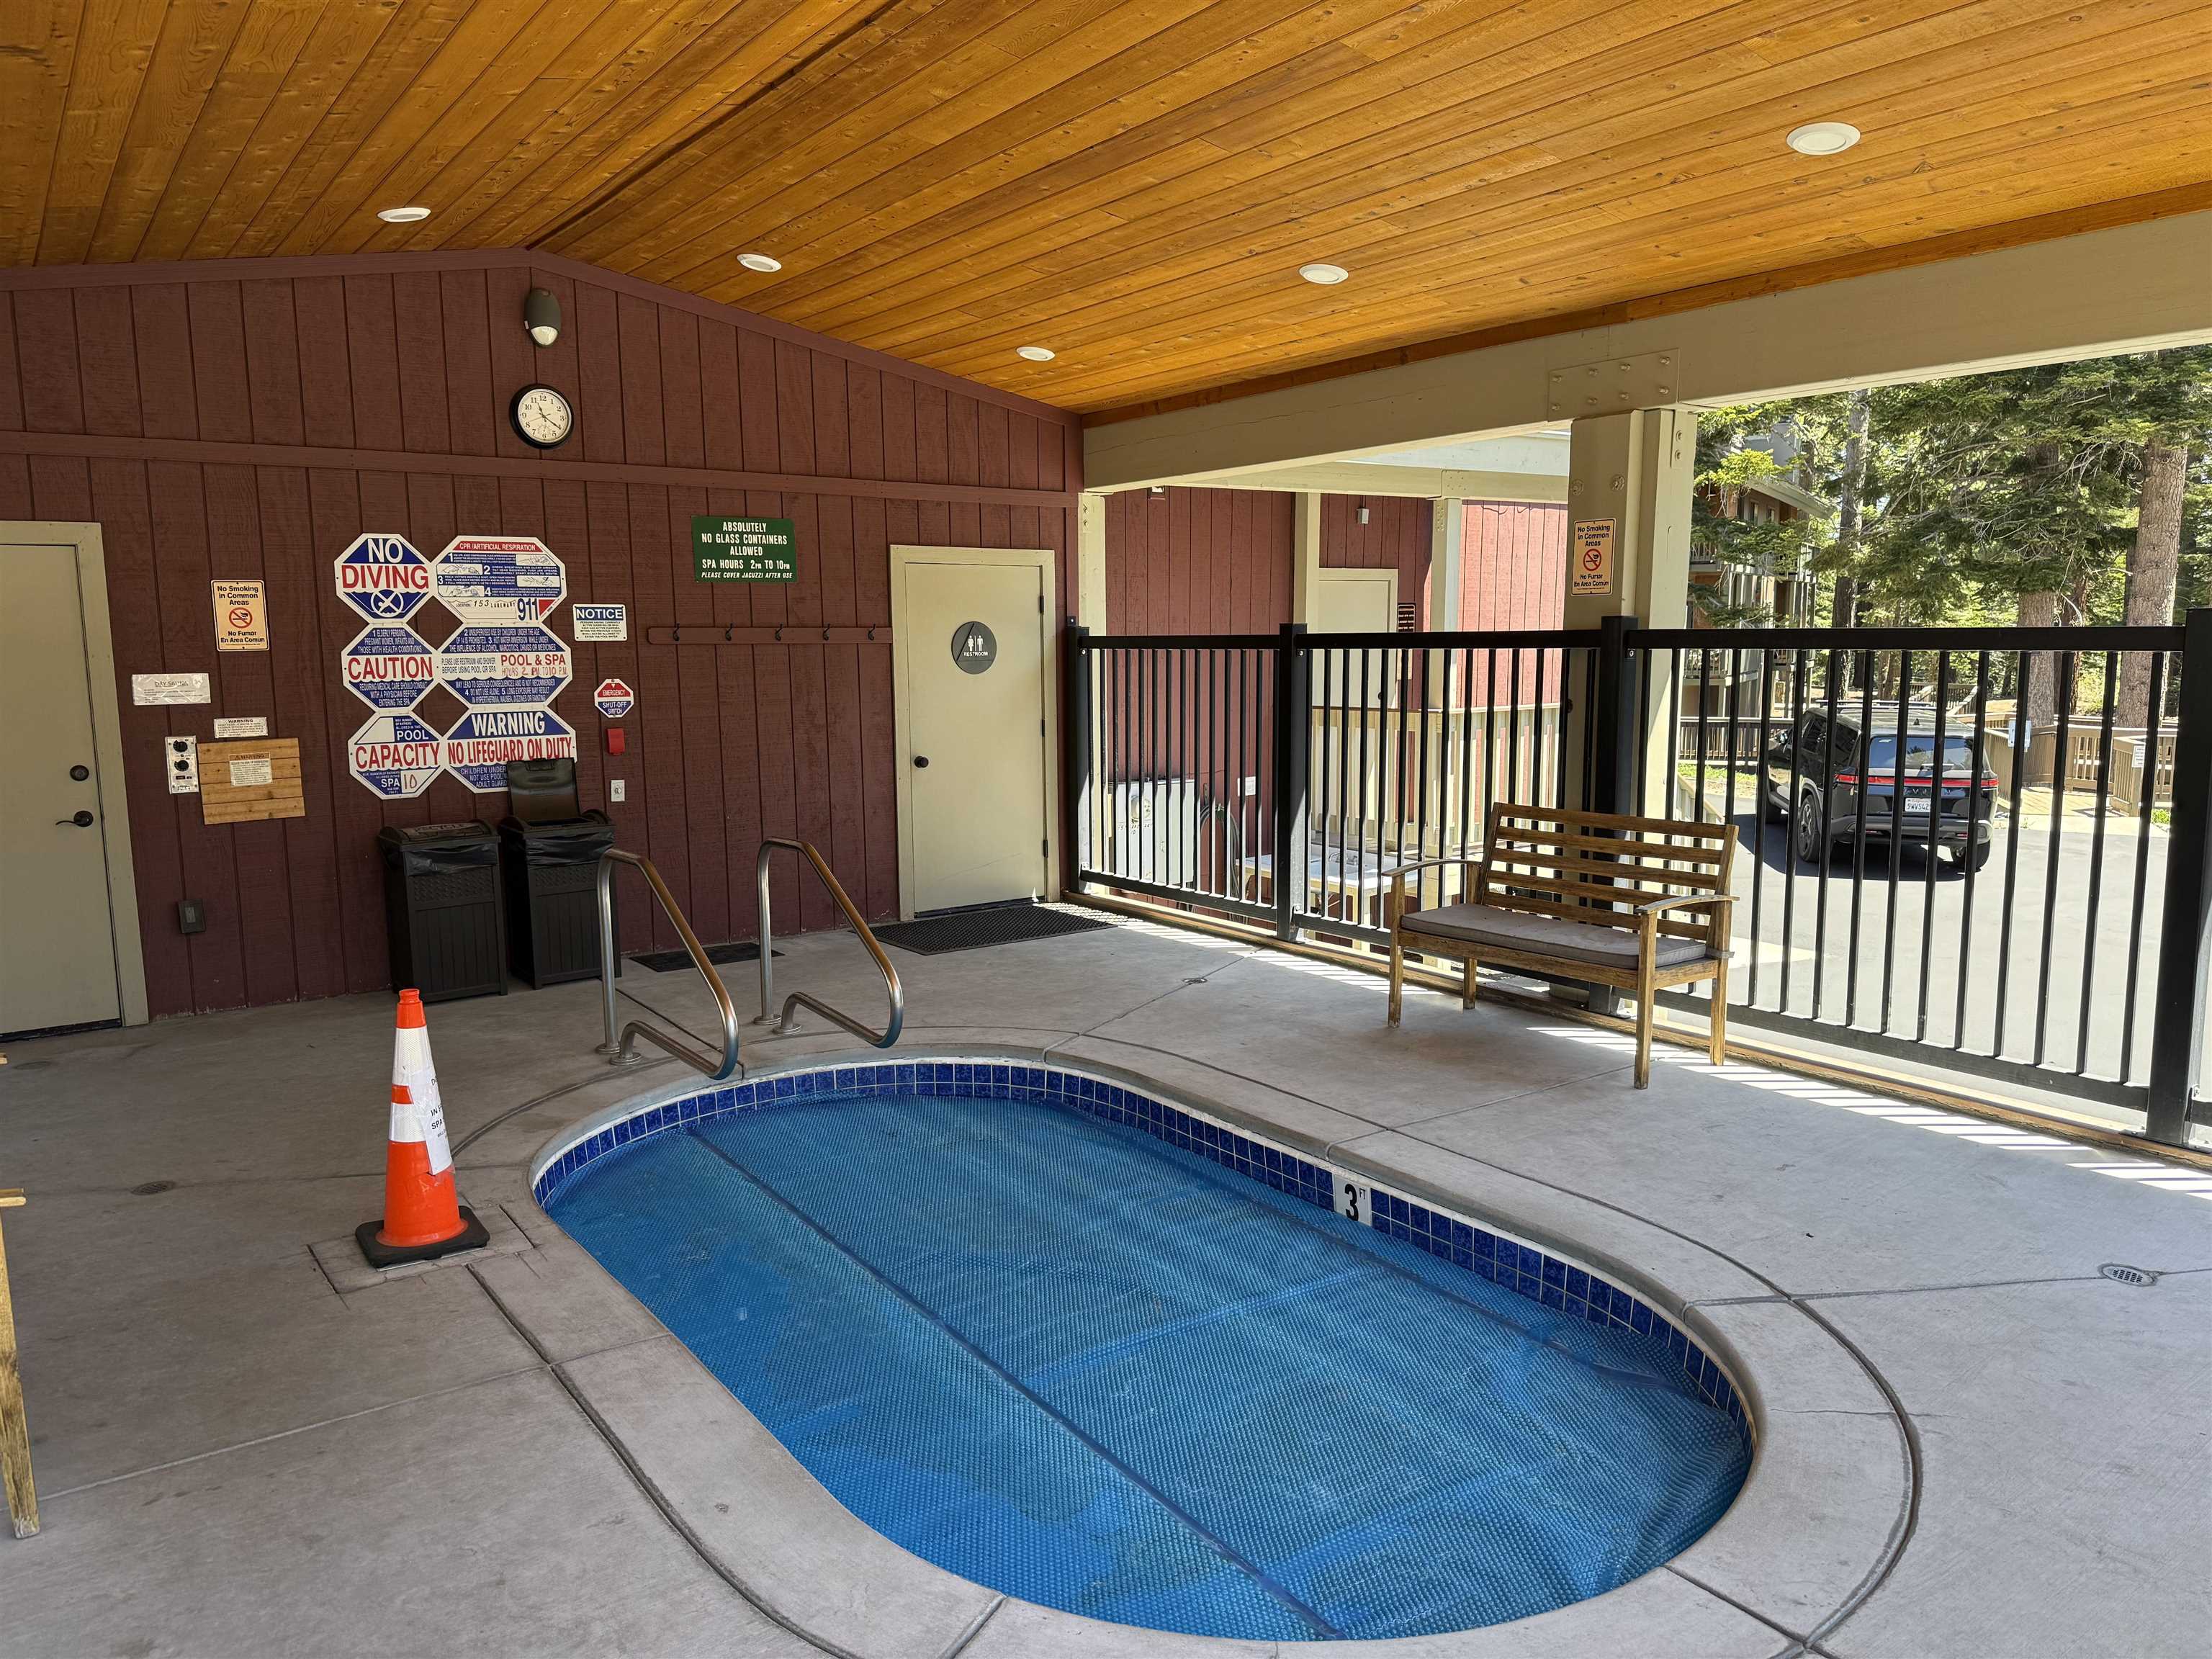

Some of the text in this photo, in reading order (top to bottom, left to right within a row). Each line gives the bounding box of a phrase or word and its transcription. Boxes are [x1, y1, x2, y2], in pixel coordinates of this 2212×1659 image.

[723, 522, 766, 532] ABSOLUTELY
[701, 533, 787, 545] NO GLASS CONTAINERS
[368, 538, 403, 563] NO
[730, 546, 763, 556] ALLOWED
[448, 553, 453, 562] 1
[702, 559, 716, 569] SPA
[720, 559, 744, 569] HOURS
[765, 560, 773, 569] TO
[484, 565, 491, 575] 2
[341, 565, 429, 589] DIVING
[438, 576, 443, 584] 3
[485, 587, 492, 596] 4
[517, 598, 538, 621] 911
[576, 609, 623, 619] NOTICE
[501, 654, 566, 666] POOL & SPA
[348, 656, 433, 680] CAUTION
[502, 667, 518, 676] HOURS
[522, 667, 528, 675] 2
[471, 712, 545, 736] WARNING
[397, 730, 429, 741] POOL
[355, 742, 440, 769] CAPACITY
[448, 737, 571, 764] NO LIFEGUARD ON DUTY
[381, 778, 400, 787] SPA
[404, 774, 417, 789] 10
[1345, 1184, 1366, 1221] 3 FT
